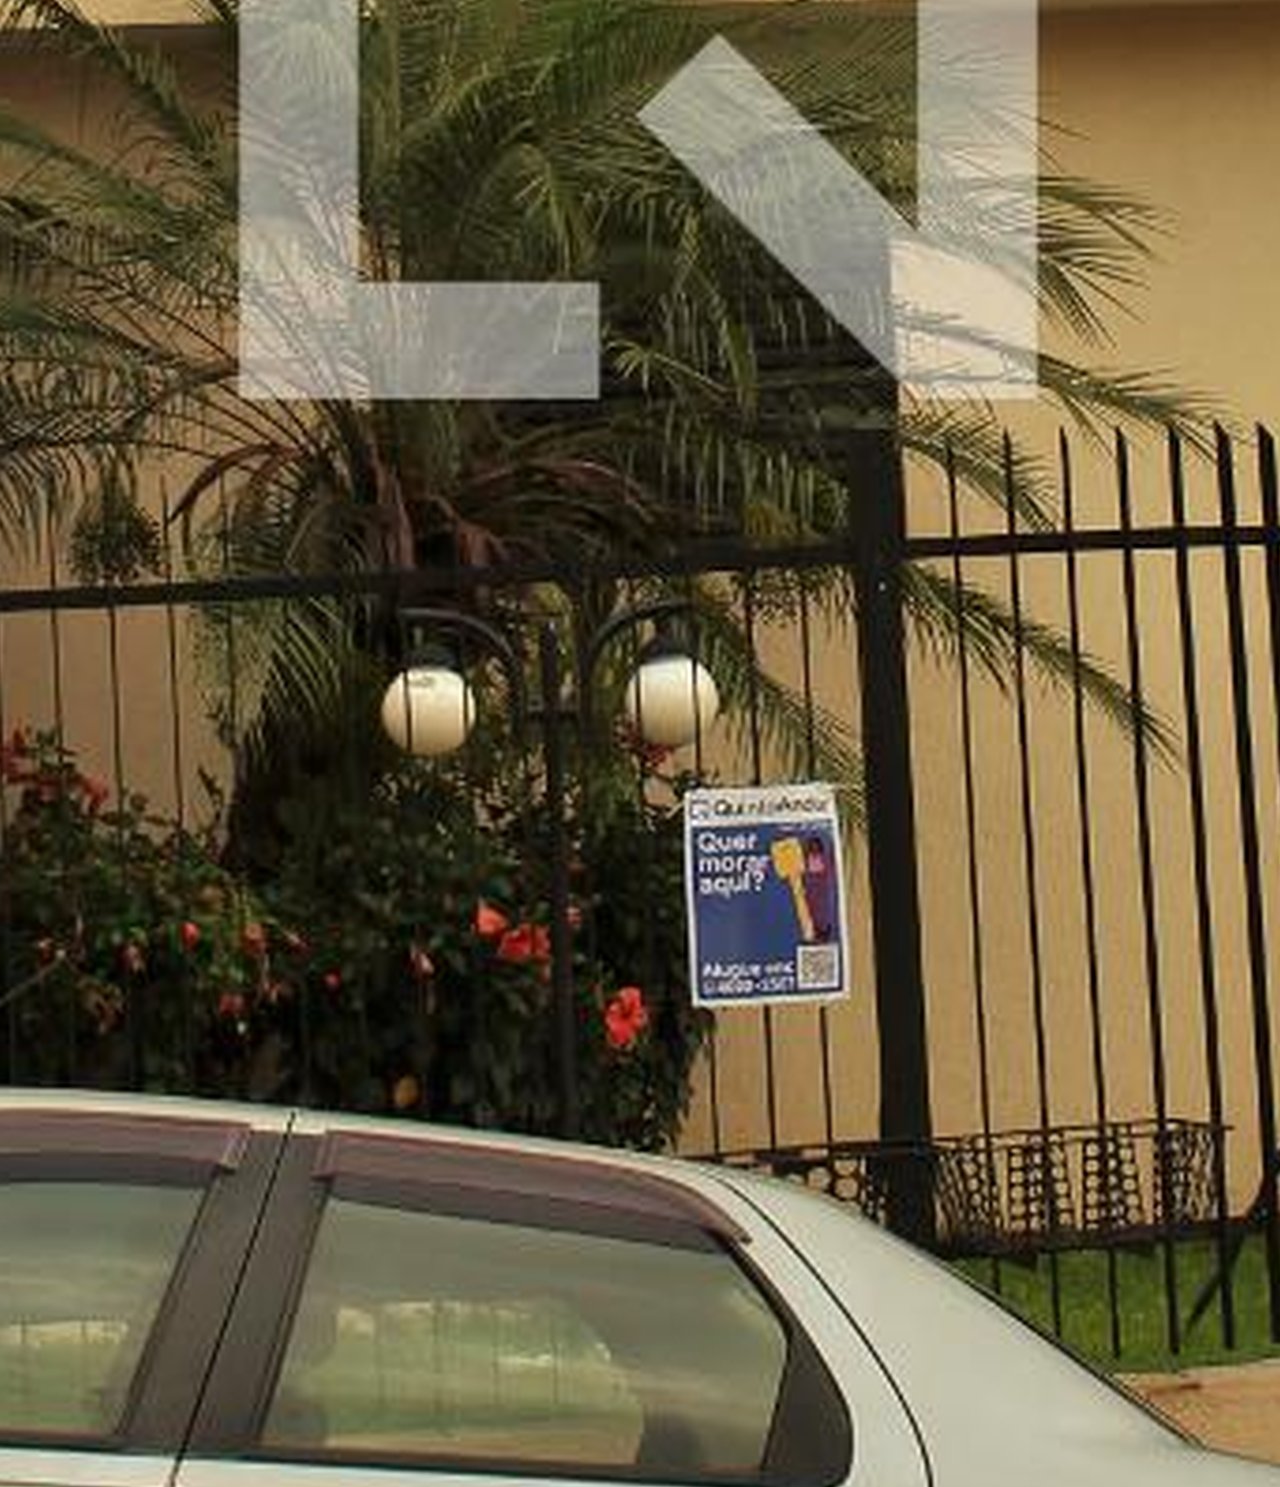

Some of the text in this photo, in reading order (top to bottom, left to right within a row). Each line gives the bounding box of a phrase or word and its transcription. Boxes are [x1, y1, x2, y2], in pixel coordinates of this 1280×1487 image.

[698, 831, 757, 853] Quer
[698, 855, 769, 874] morar
[699, 871, 765, 899] aqui?
